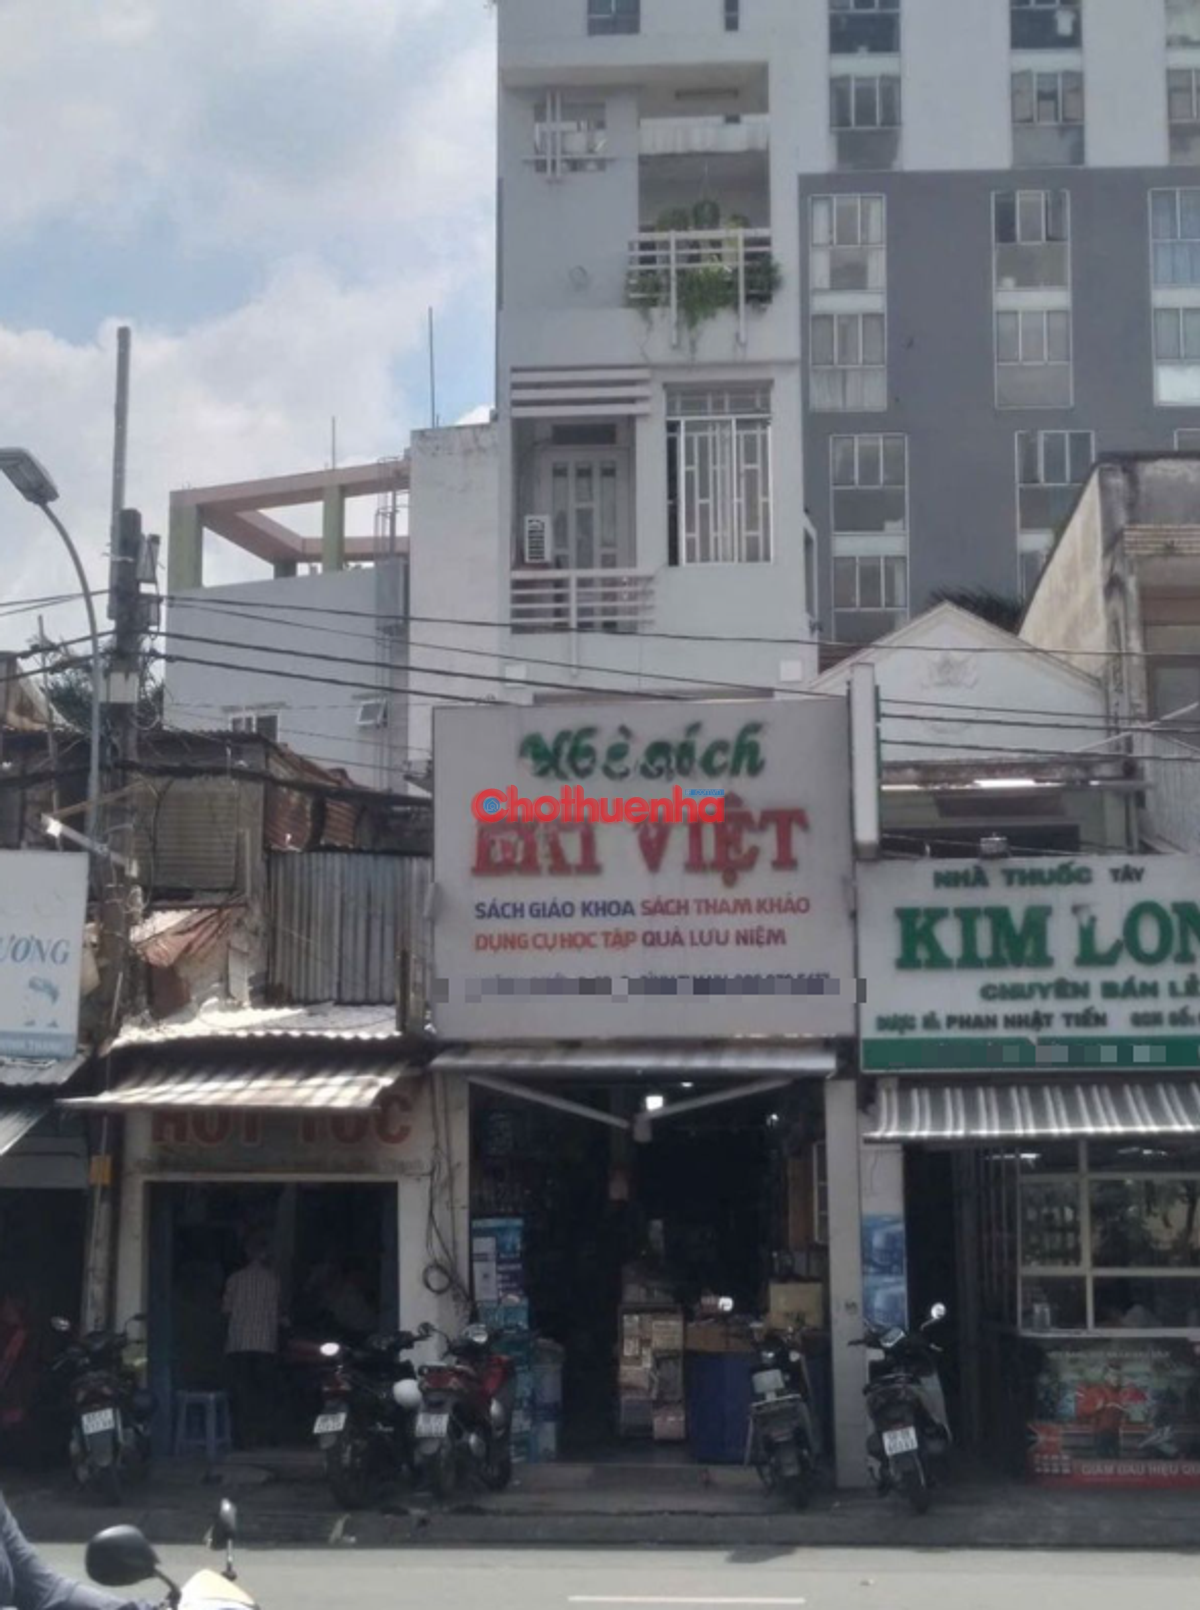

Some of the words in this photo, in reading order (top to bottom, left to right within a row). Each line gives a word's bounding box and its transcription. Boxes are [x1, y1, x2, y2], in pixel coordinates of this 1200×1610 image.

[933, 866, 989, 888] NHÀ
[1003, 861, 1093, 887] THUỐC
[475, 898, 525, 920] SÁCH
[529, 898, 575, 919] GIÁO
[581, 900, 635, 918] KHOA
[641, 896, 689, 917] SÁCH
[475, 931, 529, 953] DỤNG
[735, 925, 787, 948] NIỆM
[893, 904, 1055, 970] KIM
[945, 1013, 997, 1029] PHAN
[1003, 1008, 1055, 1032] NHẬT
[1061, 1004, 1107, 1028] TIẾN
